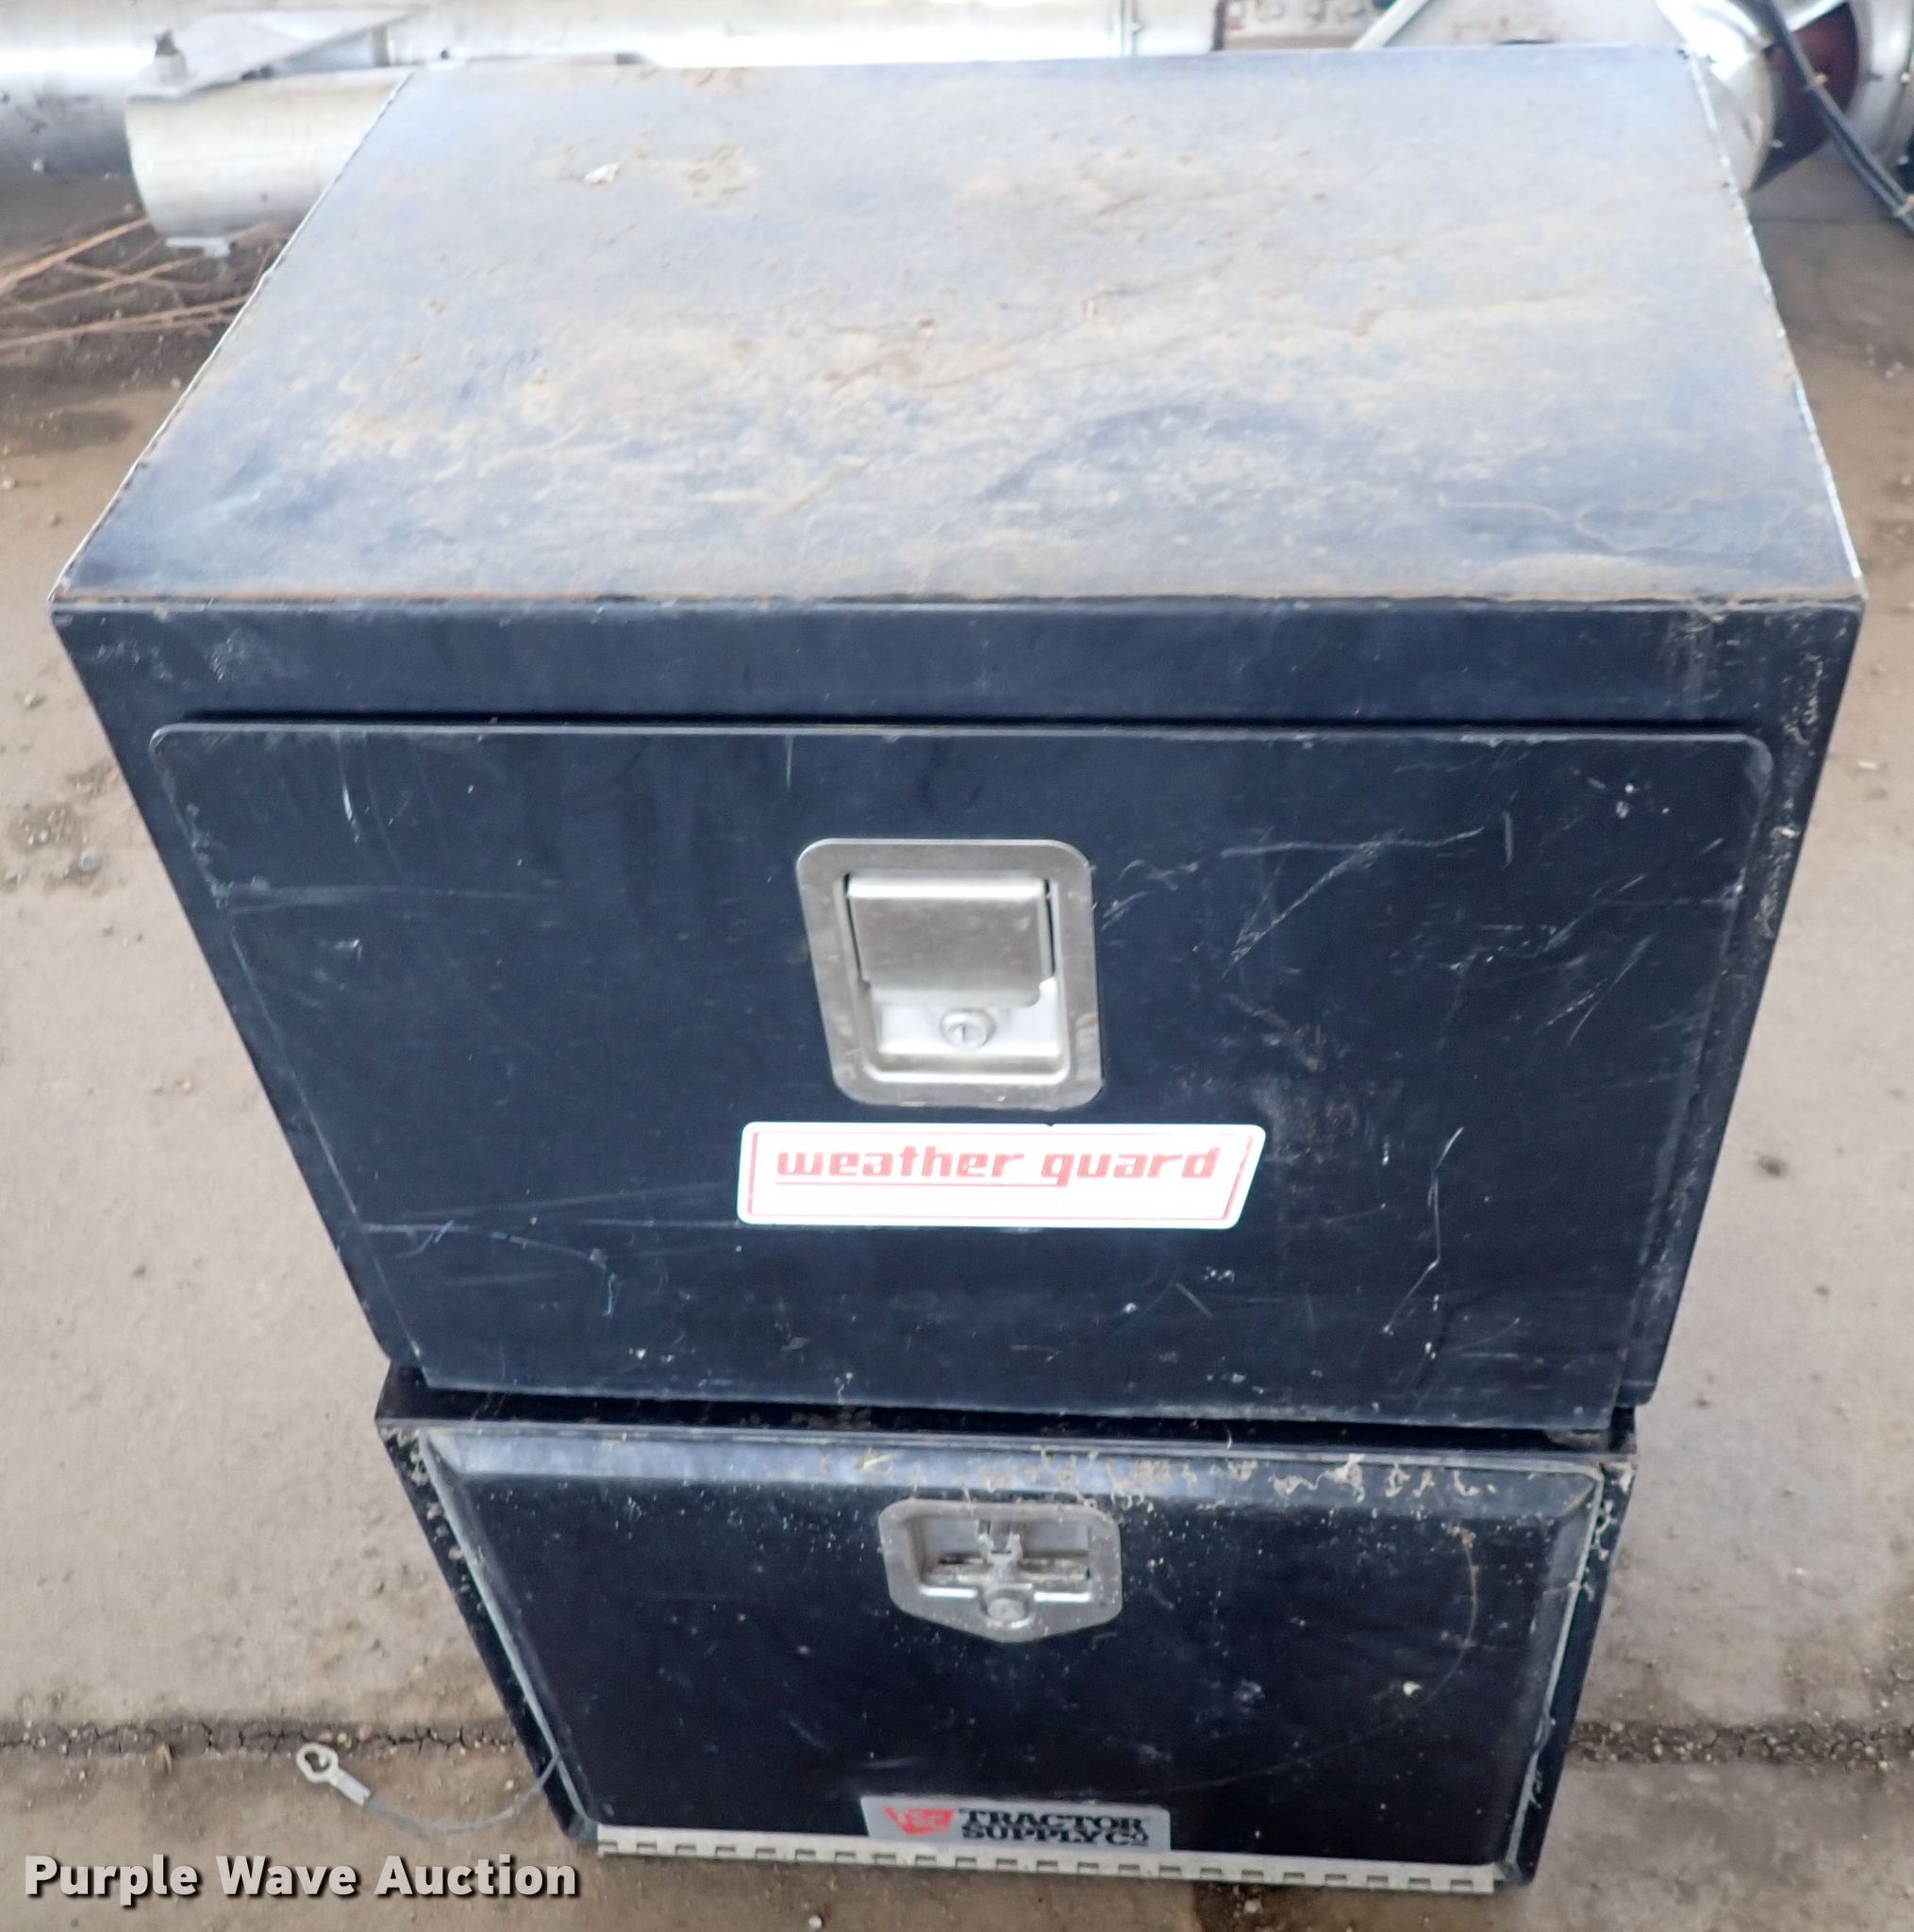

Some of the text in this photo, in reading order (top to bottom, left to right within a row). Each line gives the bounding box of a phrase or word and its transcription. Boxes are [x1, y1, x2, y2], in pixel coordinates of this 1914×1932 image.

[777, 1145, 1220, 1187] weather guard
[958, 1807, 1144, 1829] TRACTOR
[961, 1825, 1100, 1843] SUPPLY
